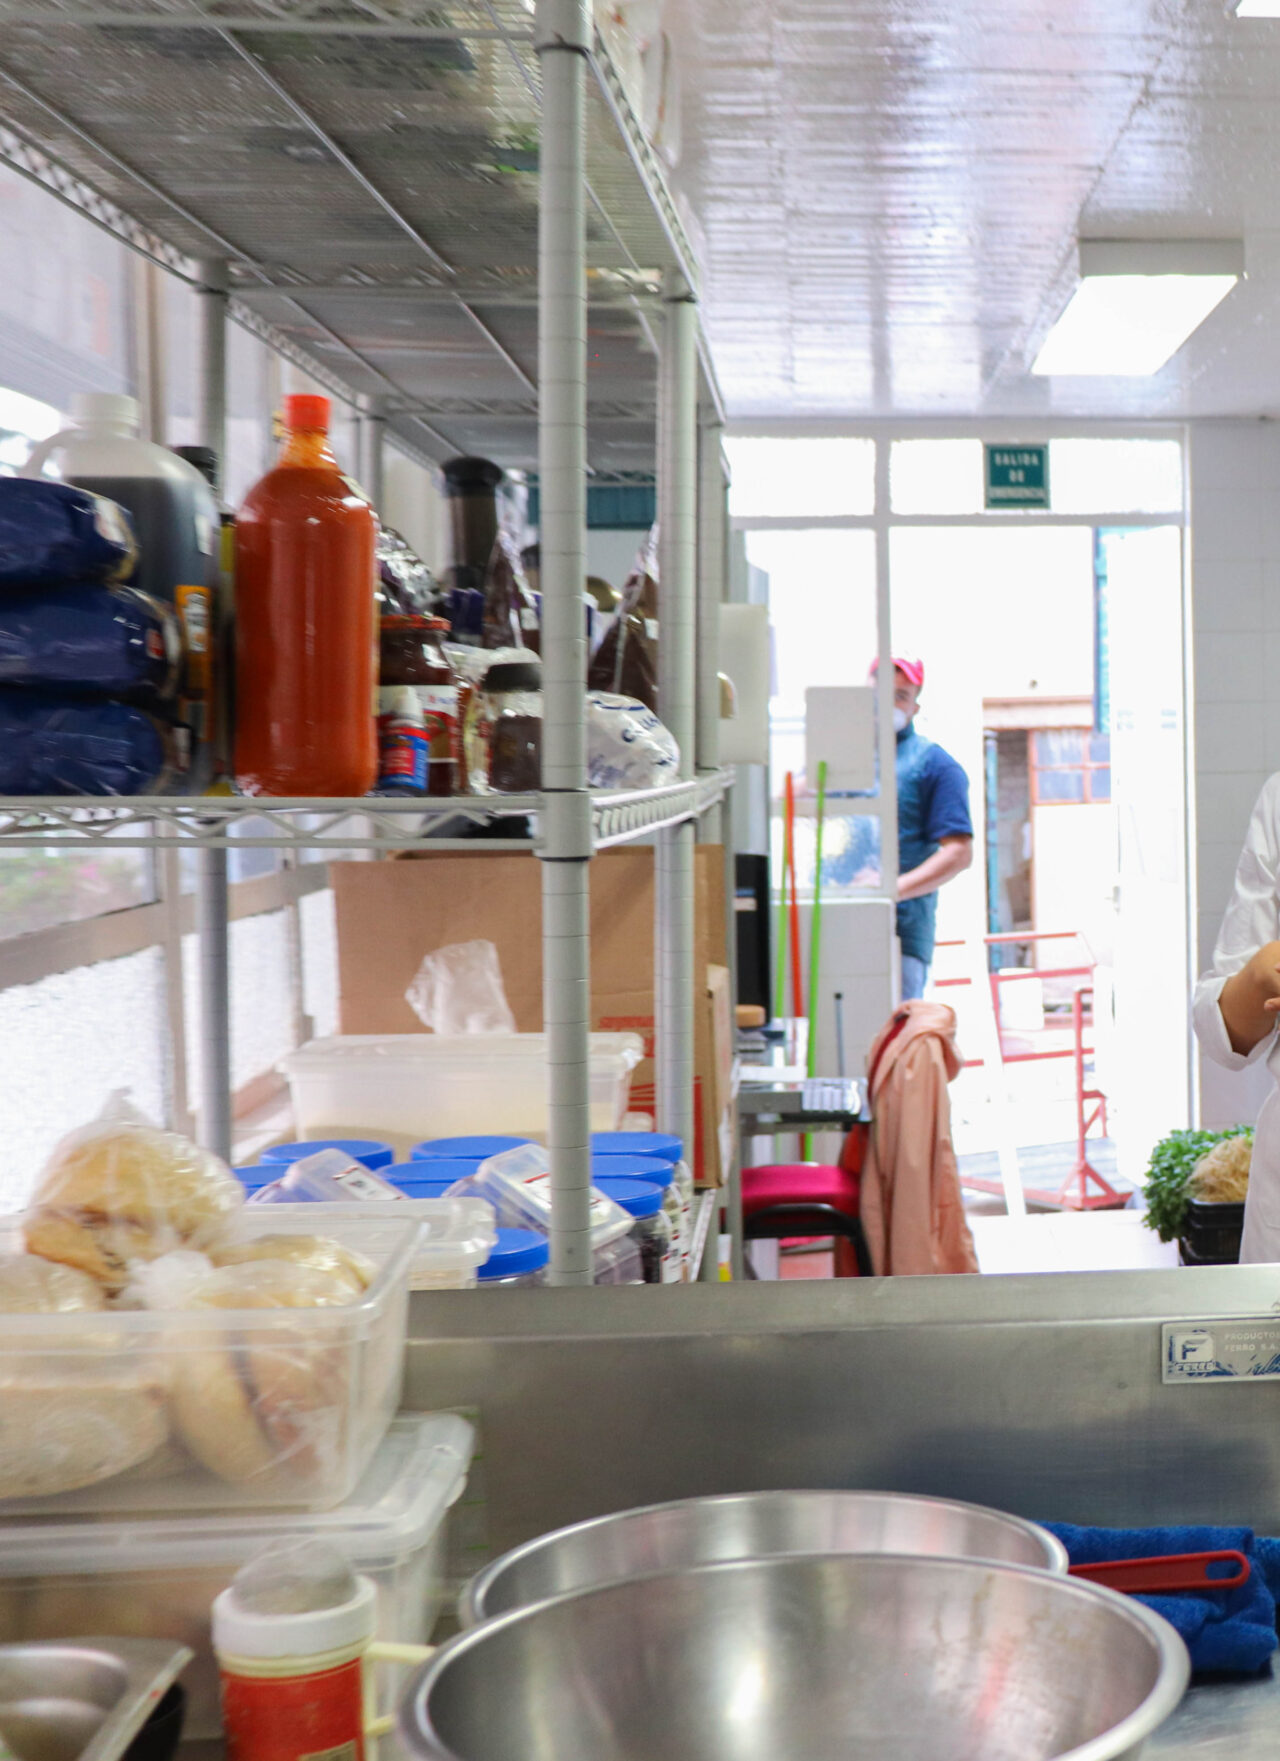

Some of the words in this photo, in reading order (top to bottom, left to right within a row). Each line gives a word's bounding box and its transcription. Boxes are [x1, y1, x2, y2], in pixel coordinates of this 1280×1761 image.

[995, 453, 1039, 466] SALIDA
[1009, 469, 1024, 482] DE
[1224, 1331, 1280, 1341] PRODUCTOS
[1224, 1343, 1256, 1352] FERRO
